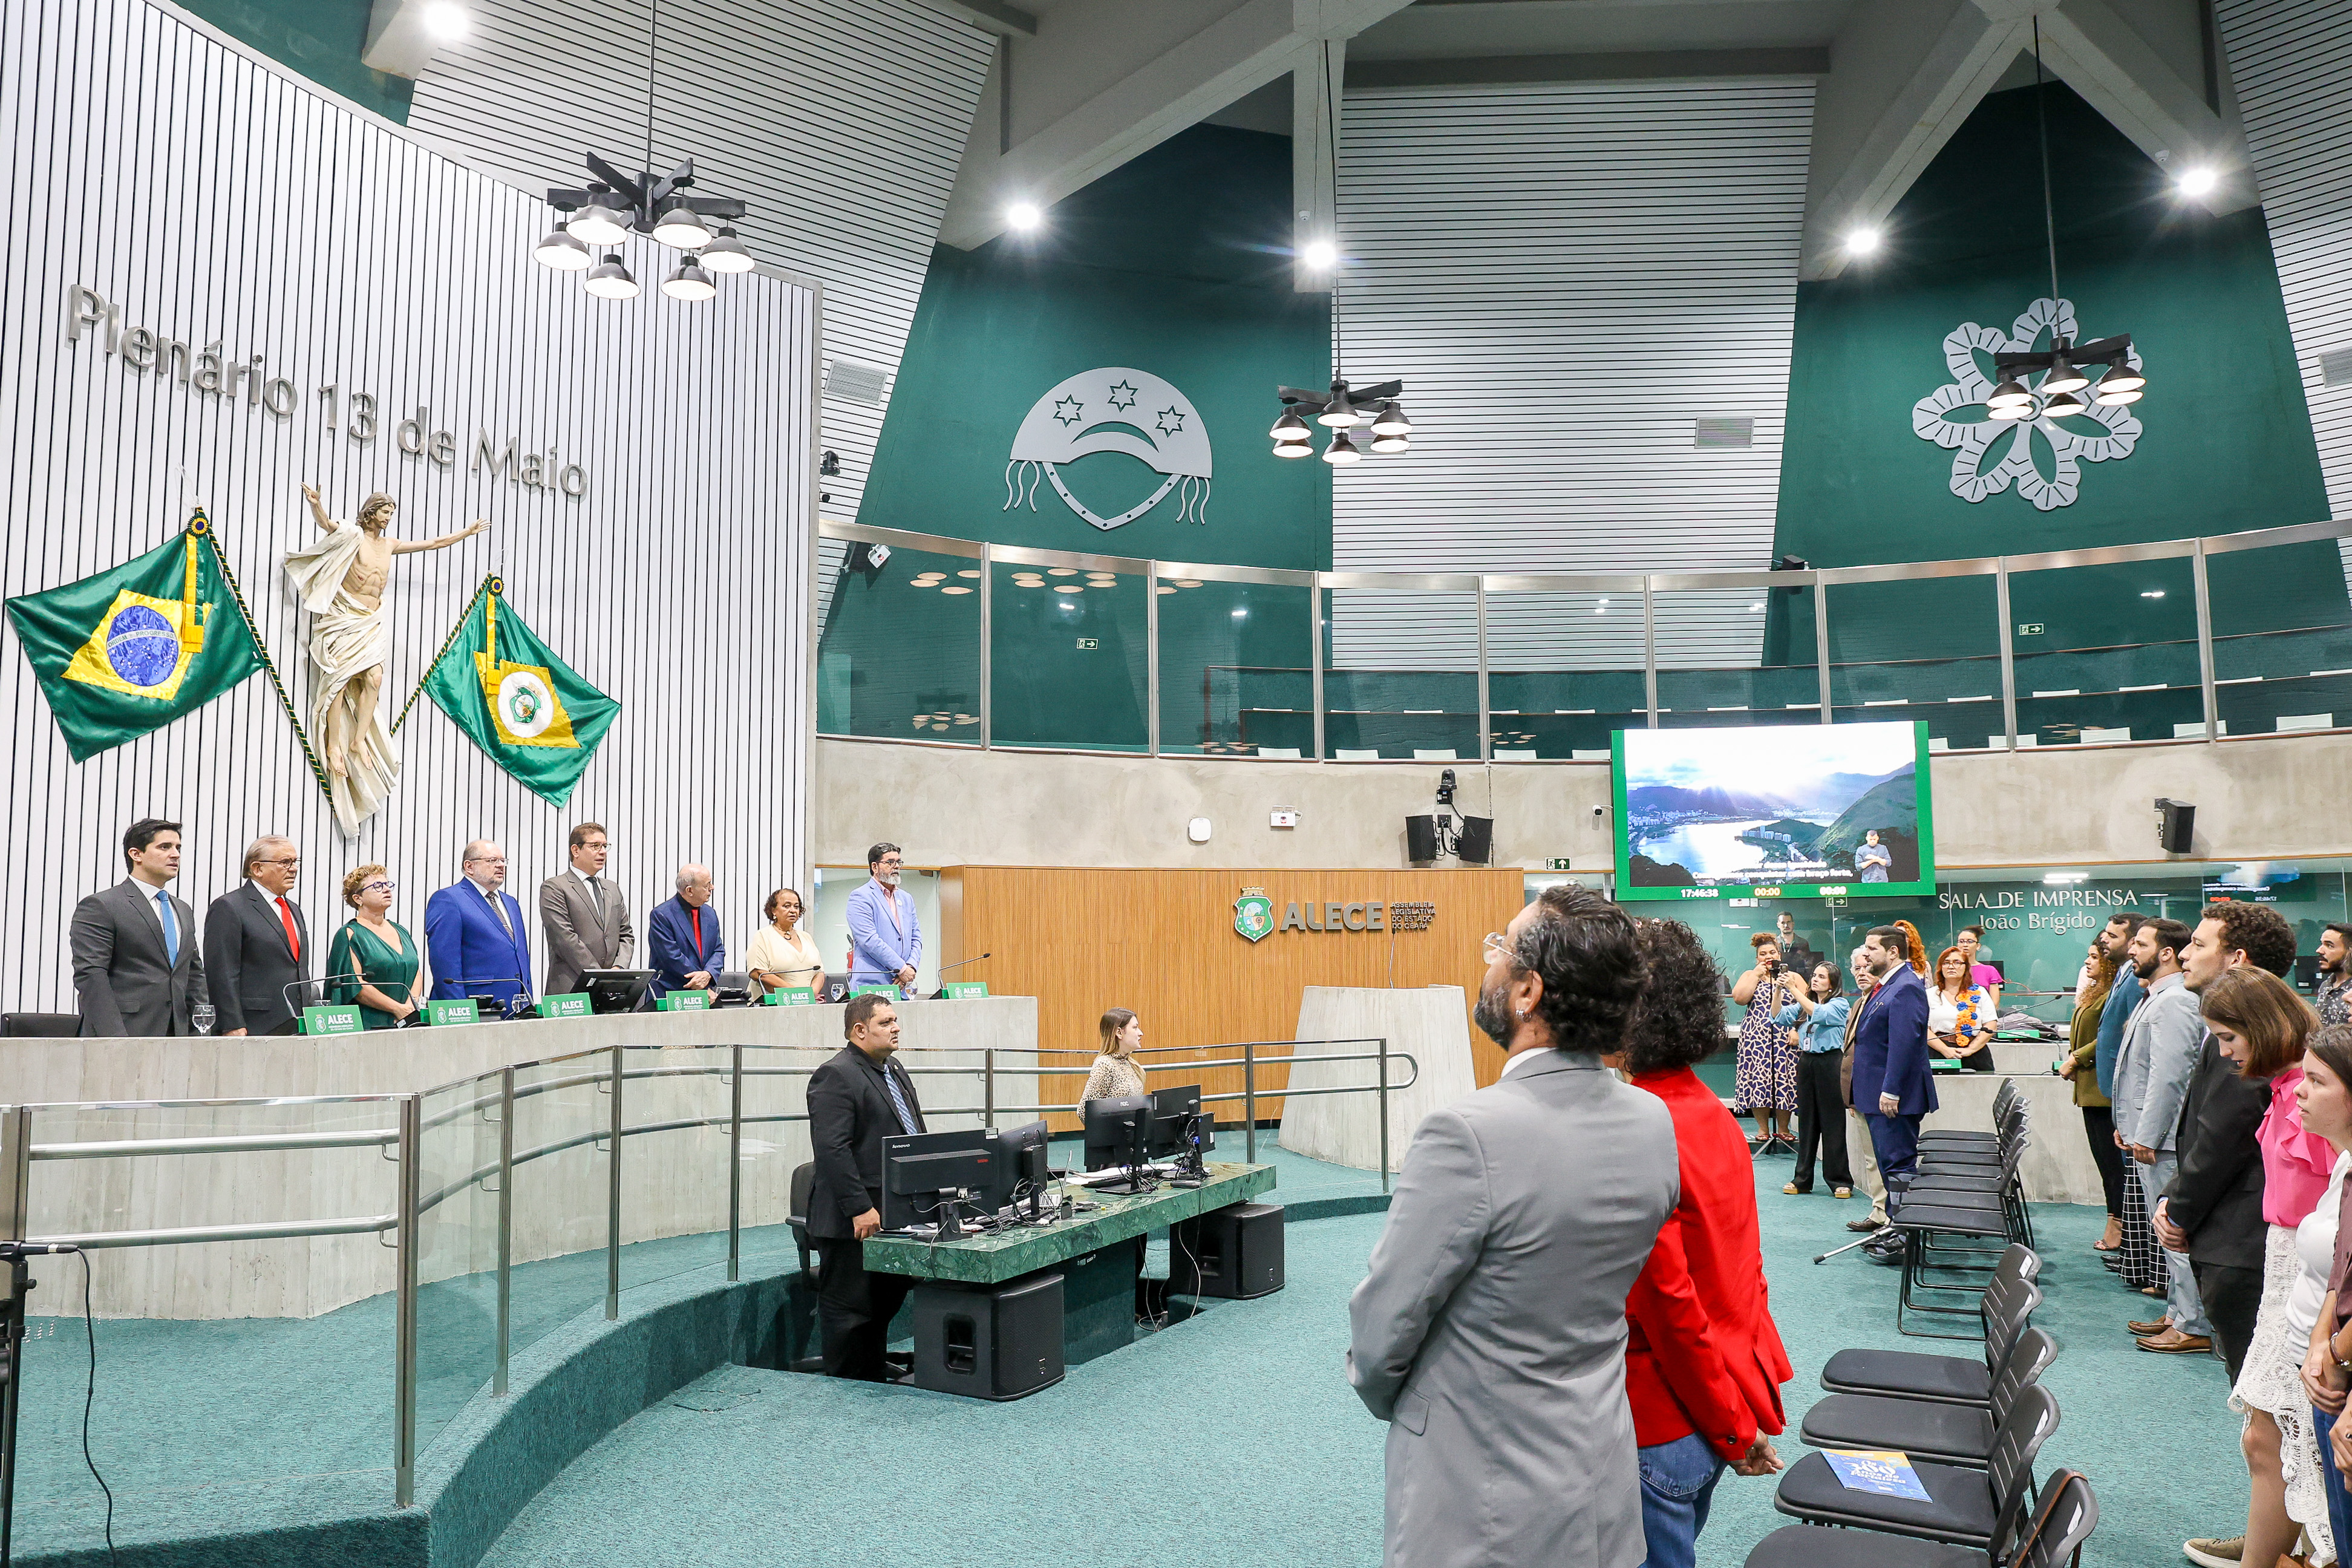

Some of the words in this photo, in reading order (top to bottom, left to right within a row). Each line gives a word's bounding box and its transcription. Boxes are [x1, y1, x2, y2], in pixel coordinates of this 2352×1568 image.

[67, 283, 297, 416] Plenário
[318, 382, 377, 440] 13
[397, 406, 456, 464] de
[472, 427, 587, 496] Maio
[108, 635, 128, 647] ORDEM
[1681, 889, 1719, 898] 17:46:38
[1754, 887, 1781, 896] 00:00
[1820, 886, 1847, 895] 00:00
[1939, 892, 1989, 909] SALA
[1998, 891, 2025, 908] DE
[2033, 889, 2138, 907] IMPRENSA
[1279, 901, 1384, 931] ALECE
[1404, 921, 1428, 929] CEARÁ
[2028, 910, 2096, 935] Brígido
[561, 1000, 584, 1010] ALECE
[448, 1007, 471, 1017] ALECE
[327, 1013, 354, 1025] ALECE
